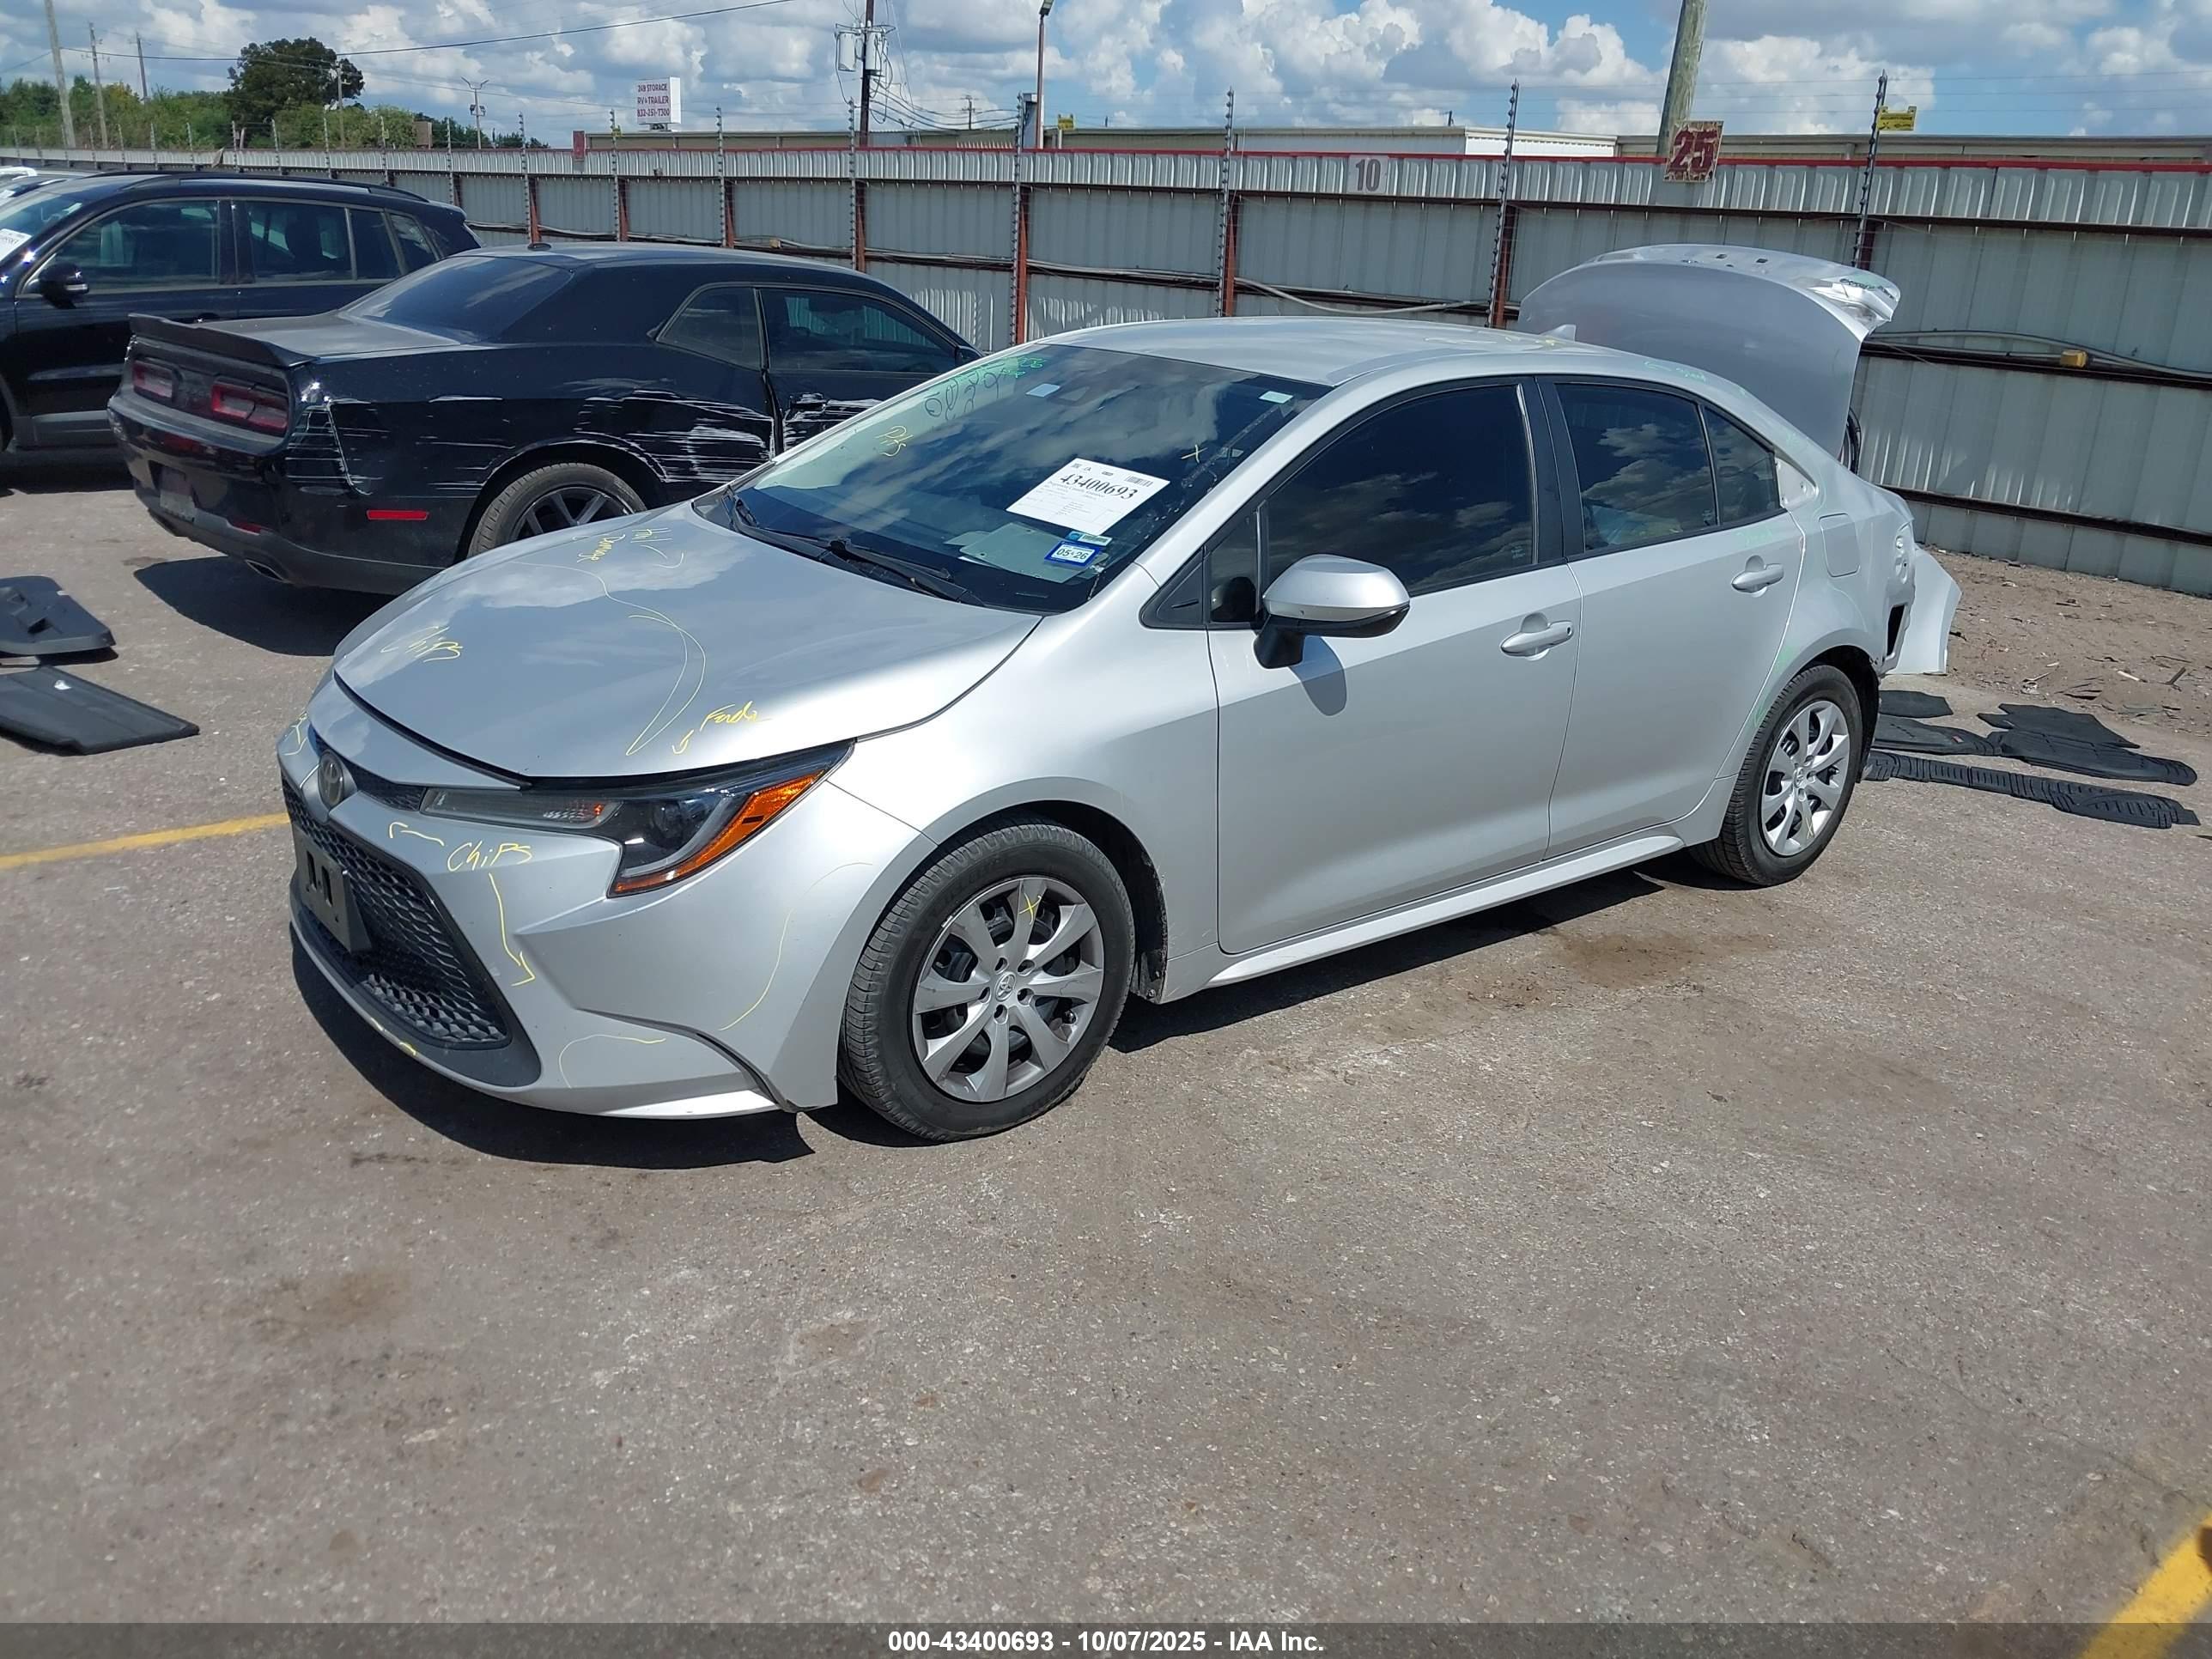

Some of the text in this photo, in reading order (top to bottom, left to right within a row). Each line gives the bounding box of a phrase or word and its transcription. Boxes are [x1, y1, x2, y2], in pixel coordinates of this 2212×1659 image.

[1668, 129, 1718, 173] 25
[1355, 159, 1382, 192] 10
[1060, 473, 1138, 500] 43400693
[1056, 548, 1072, 557] 05
[1073, 551, 1089, 560] 26
